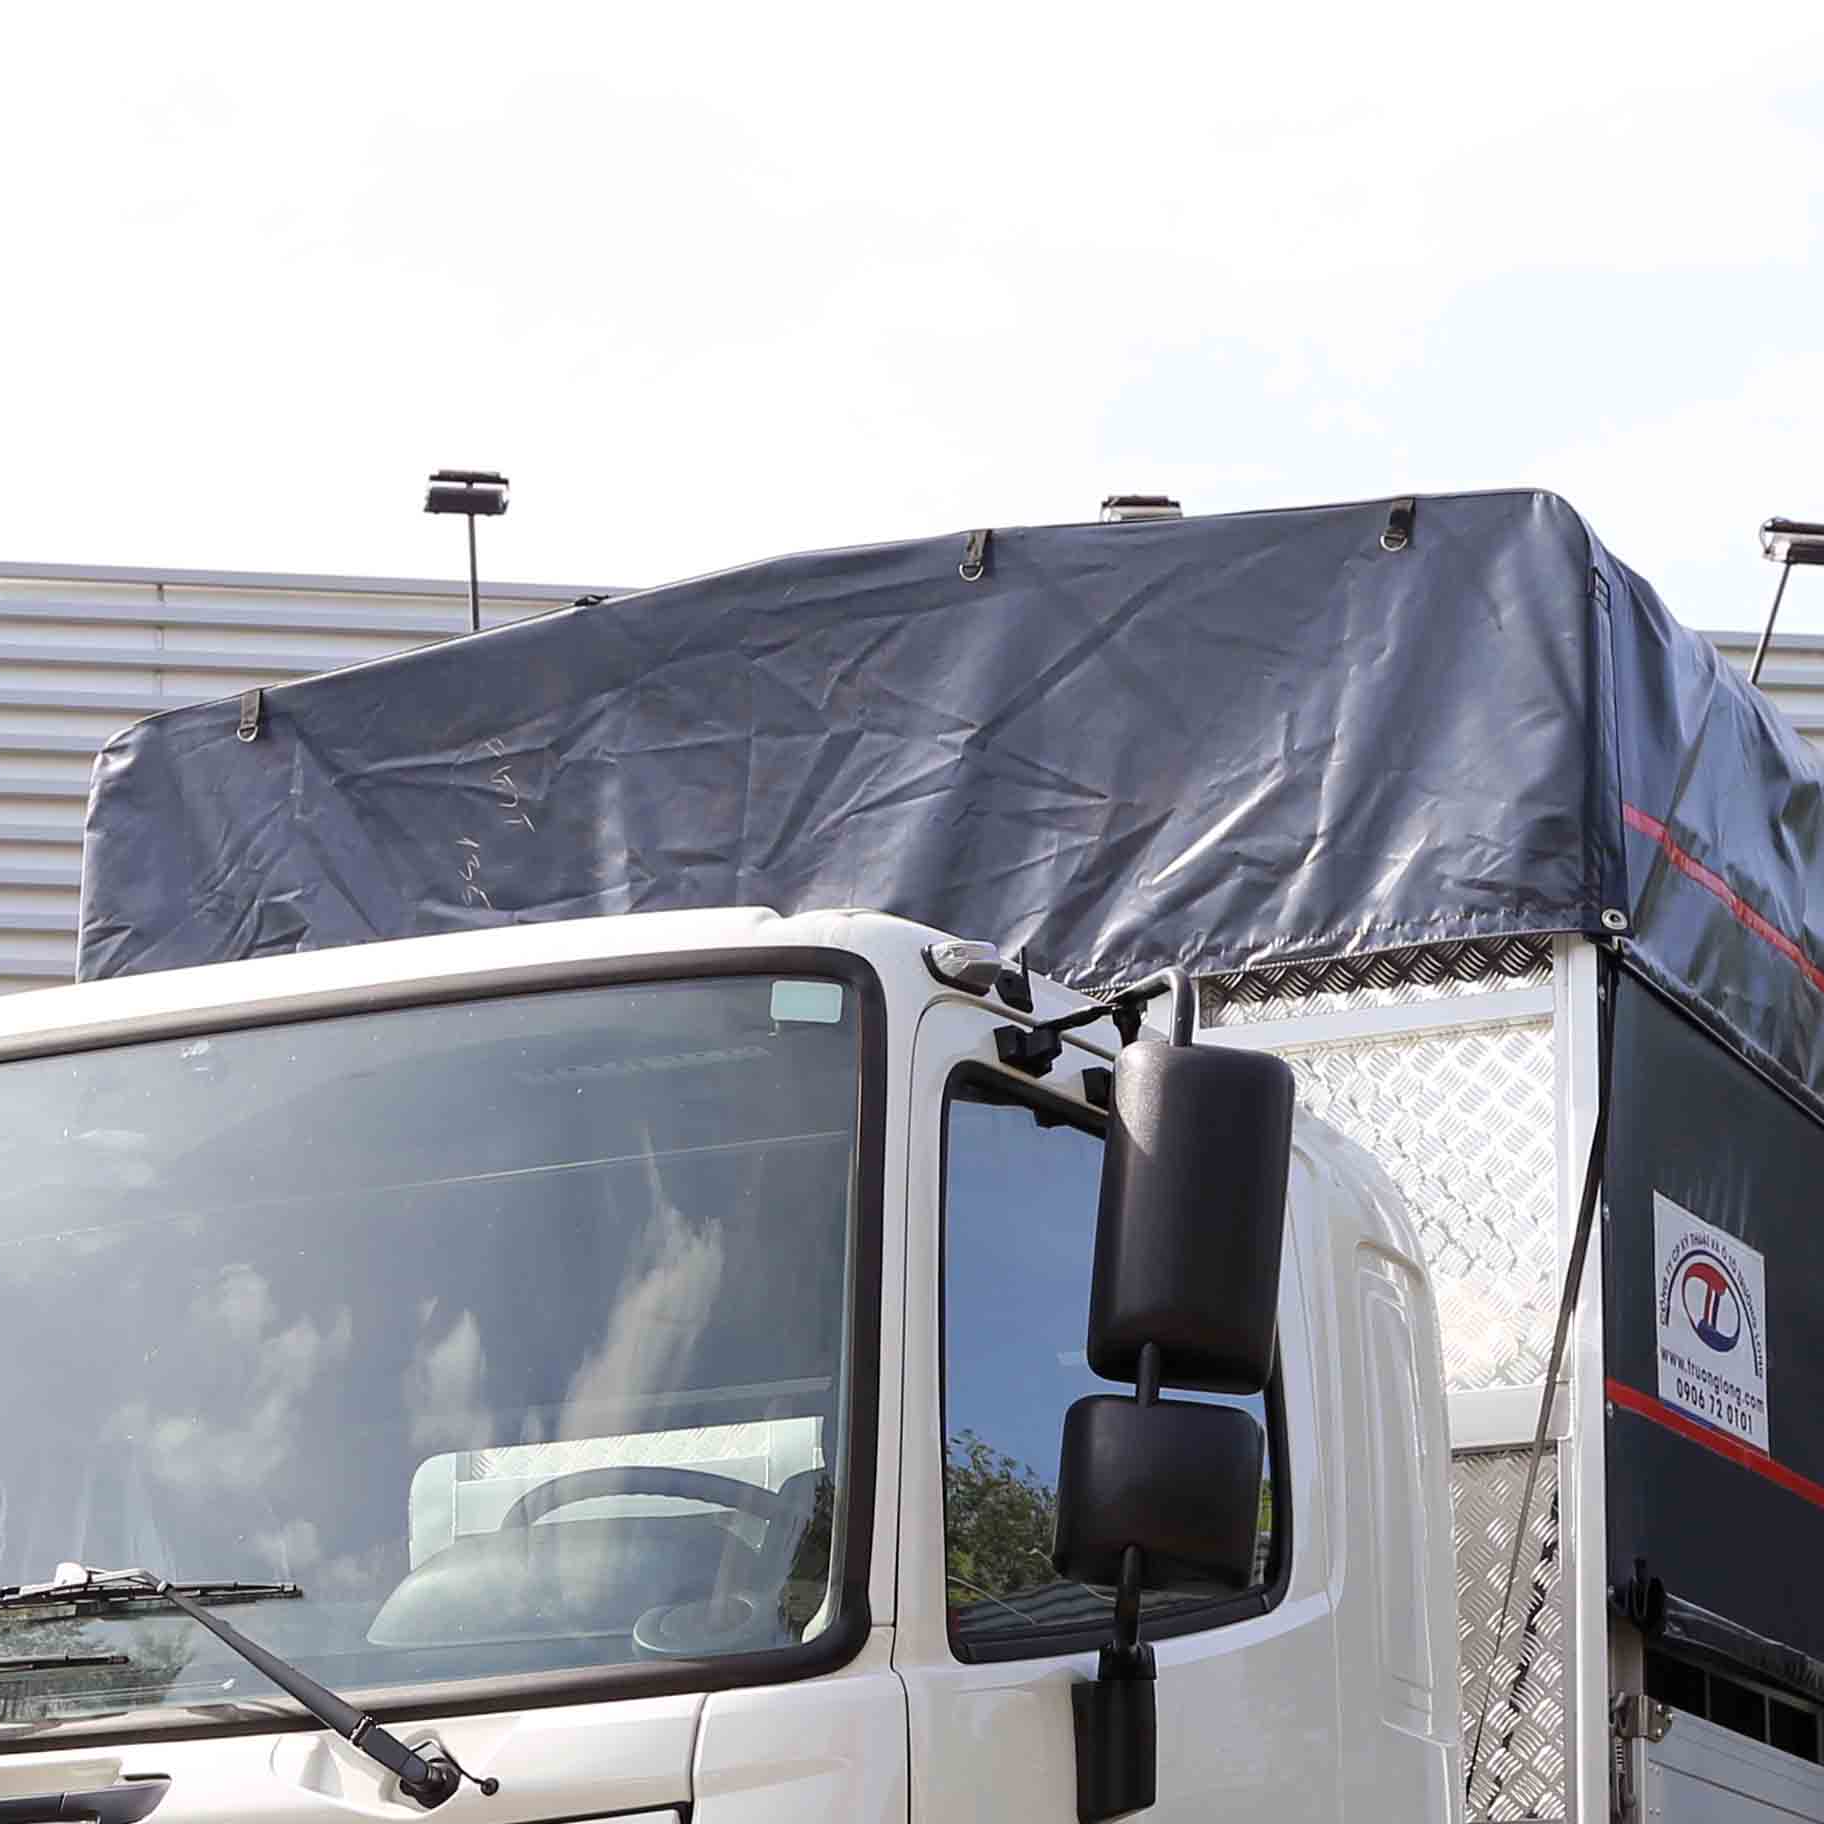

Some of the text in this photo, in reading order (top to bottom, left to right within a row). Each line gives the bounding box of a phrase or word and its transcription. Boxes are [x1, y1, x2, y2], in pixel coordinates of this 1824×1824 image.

[1661, 1347, 1764, 1415] www.truonglong.com
[1677, 1377, 1753, 1435] 0906 72 0101
